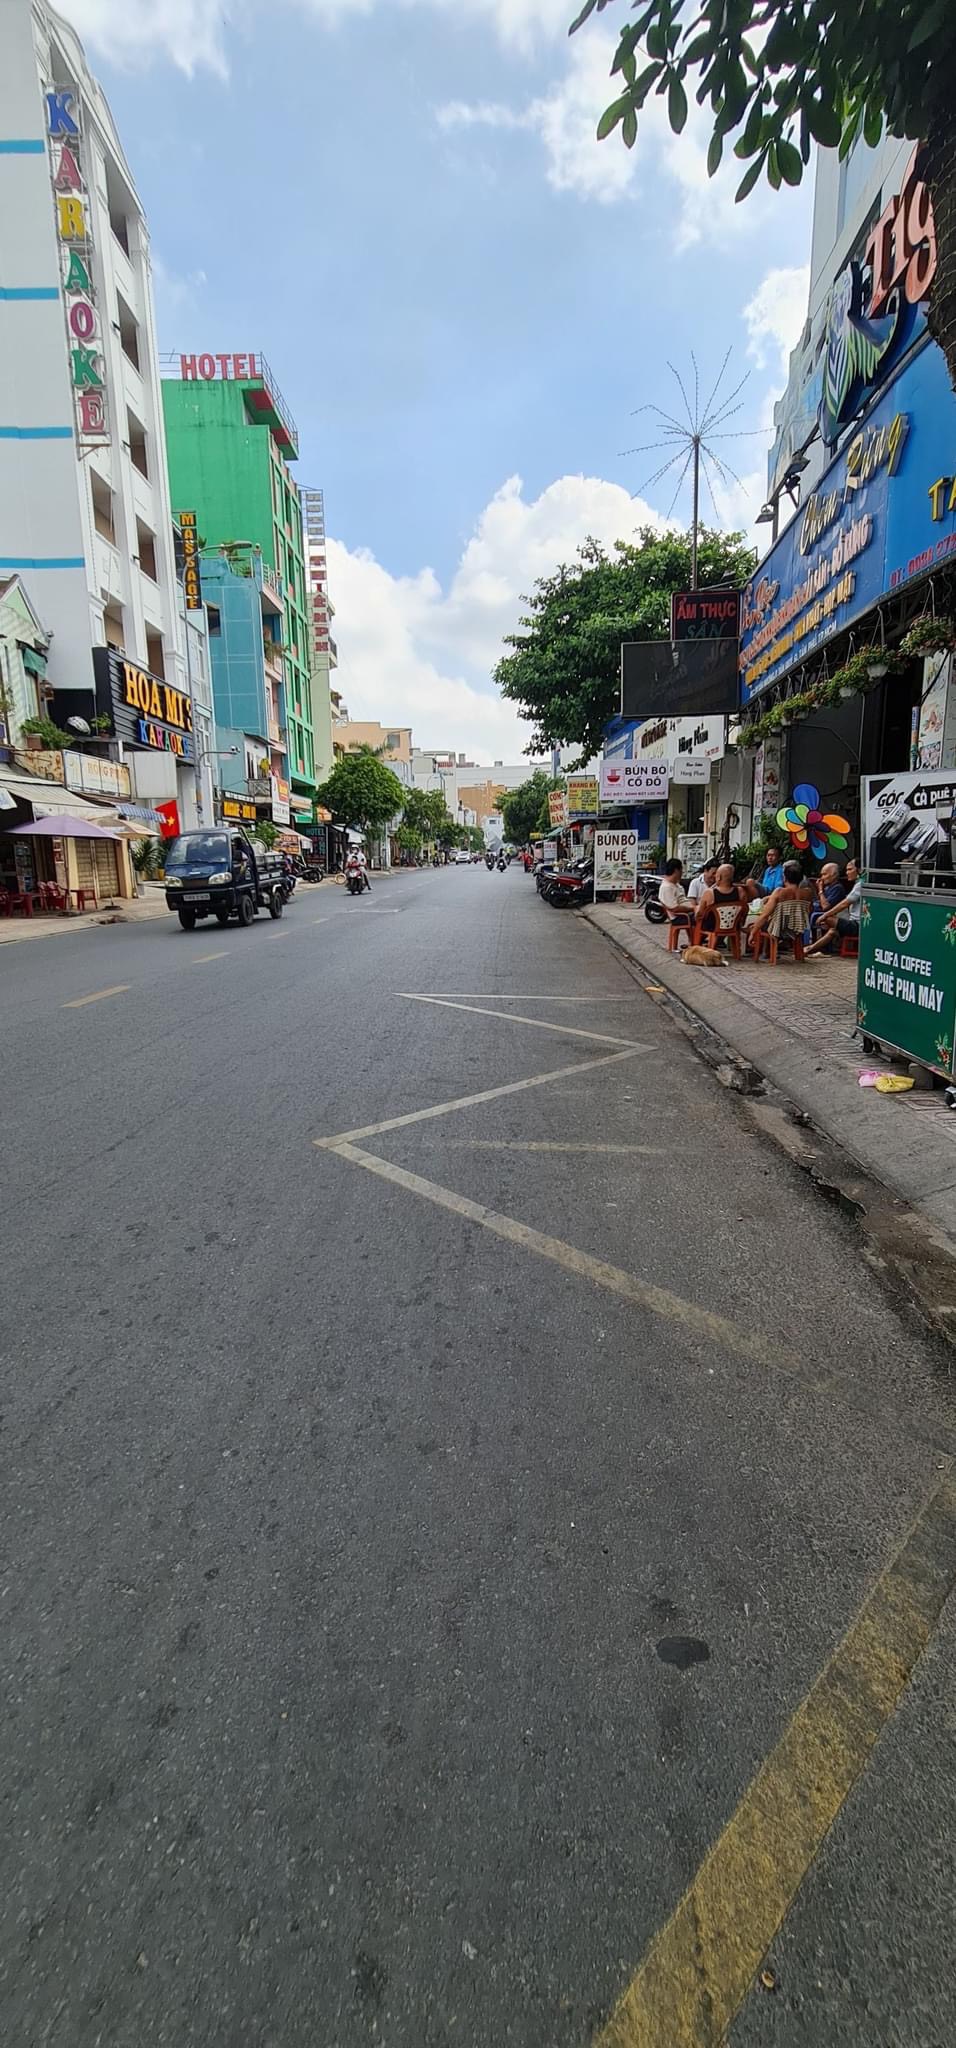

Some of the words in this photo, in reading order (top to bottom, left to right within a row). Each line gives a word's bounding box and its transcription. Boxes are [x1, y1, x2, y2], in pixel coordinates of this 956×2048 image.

[45, 92, 106, 436] KARAOKE
[180, 353, 263, 380] HOTEL
[179, 512, 200, 610] MASSAGE
[700, 602, 736, 621] THỰC
[138, 718, 190, 758] KARAOKE
[624, 764, 648, 775] BÚN
[651, 764, 667, 775] BÒ
[597, 832, 622, 846] BÚN
[622, 833, 636, 846] BÒ
[604, 846, 628, 862] HUẾ
[874, 948, 899, 968] SILOFA
[900, 954, 932, 977] COFFEE
[864, 965, 876, 990] CÀ
[877, 971, 894, 997] PHÊ
[895, 977, 916, 1004] PHA
[918, 983, 944, 1013] MÁY
